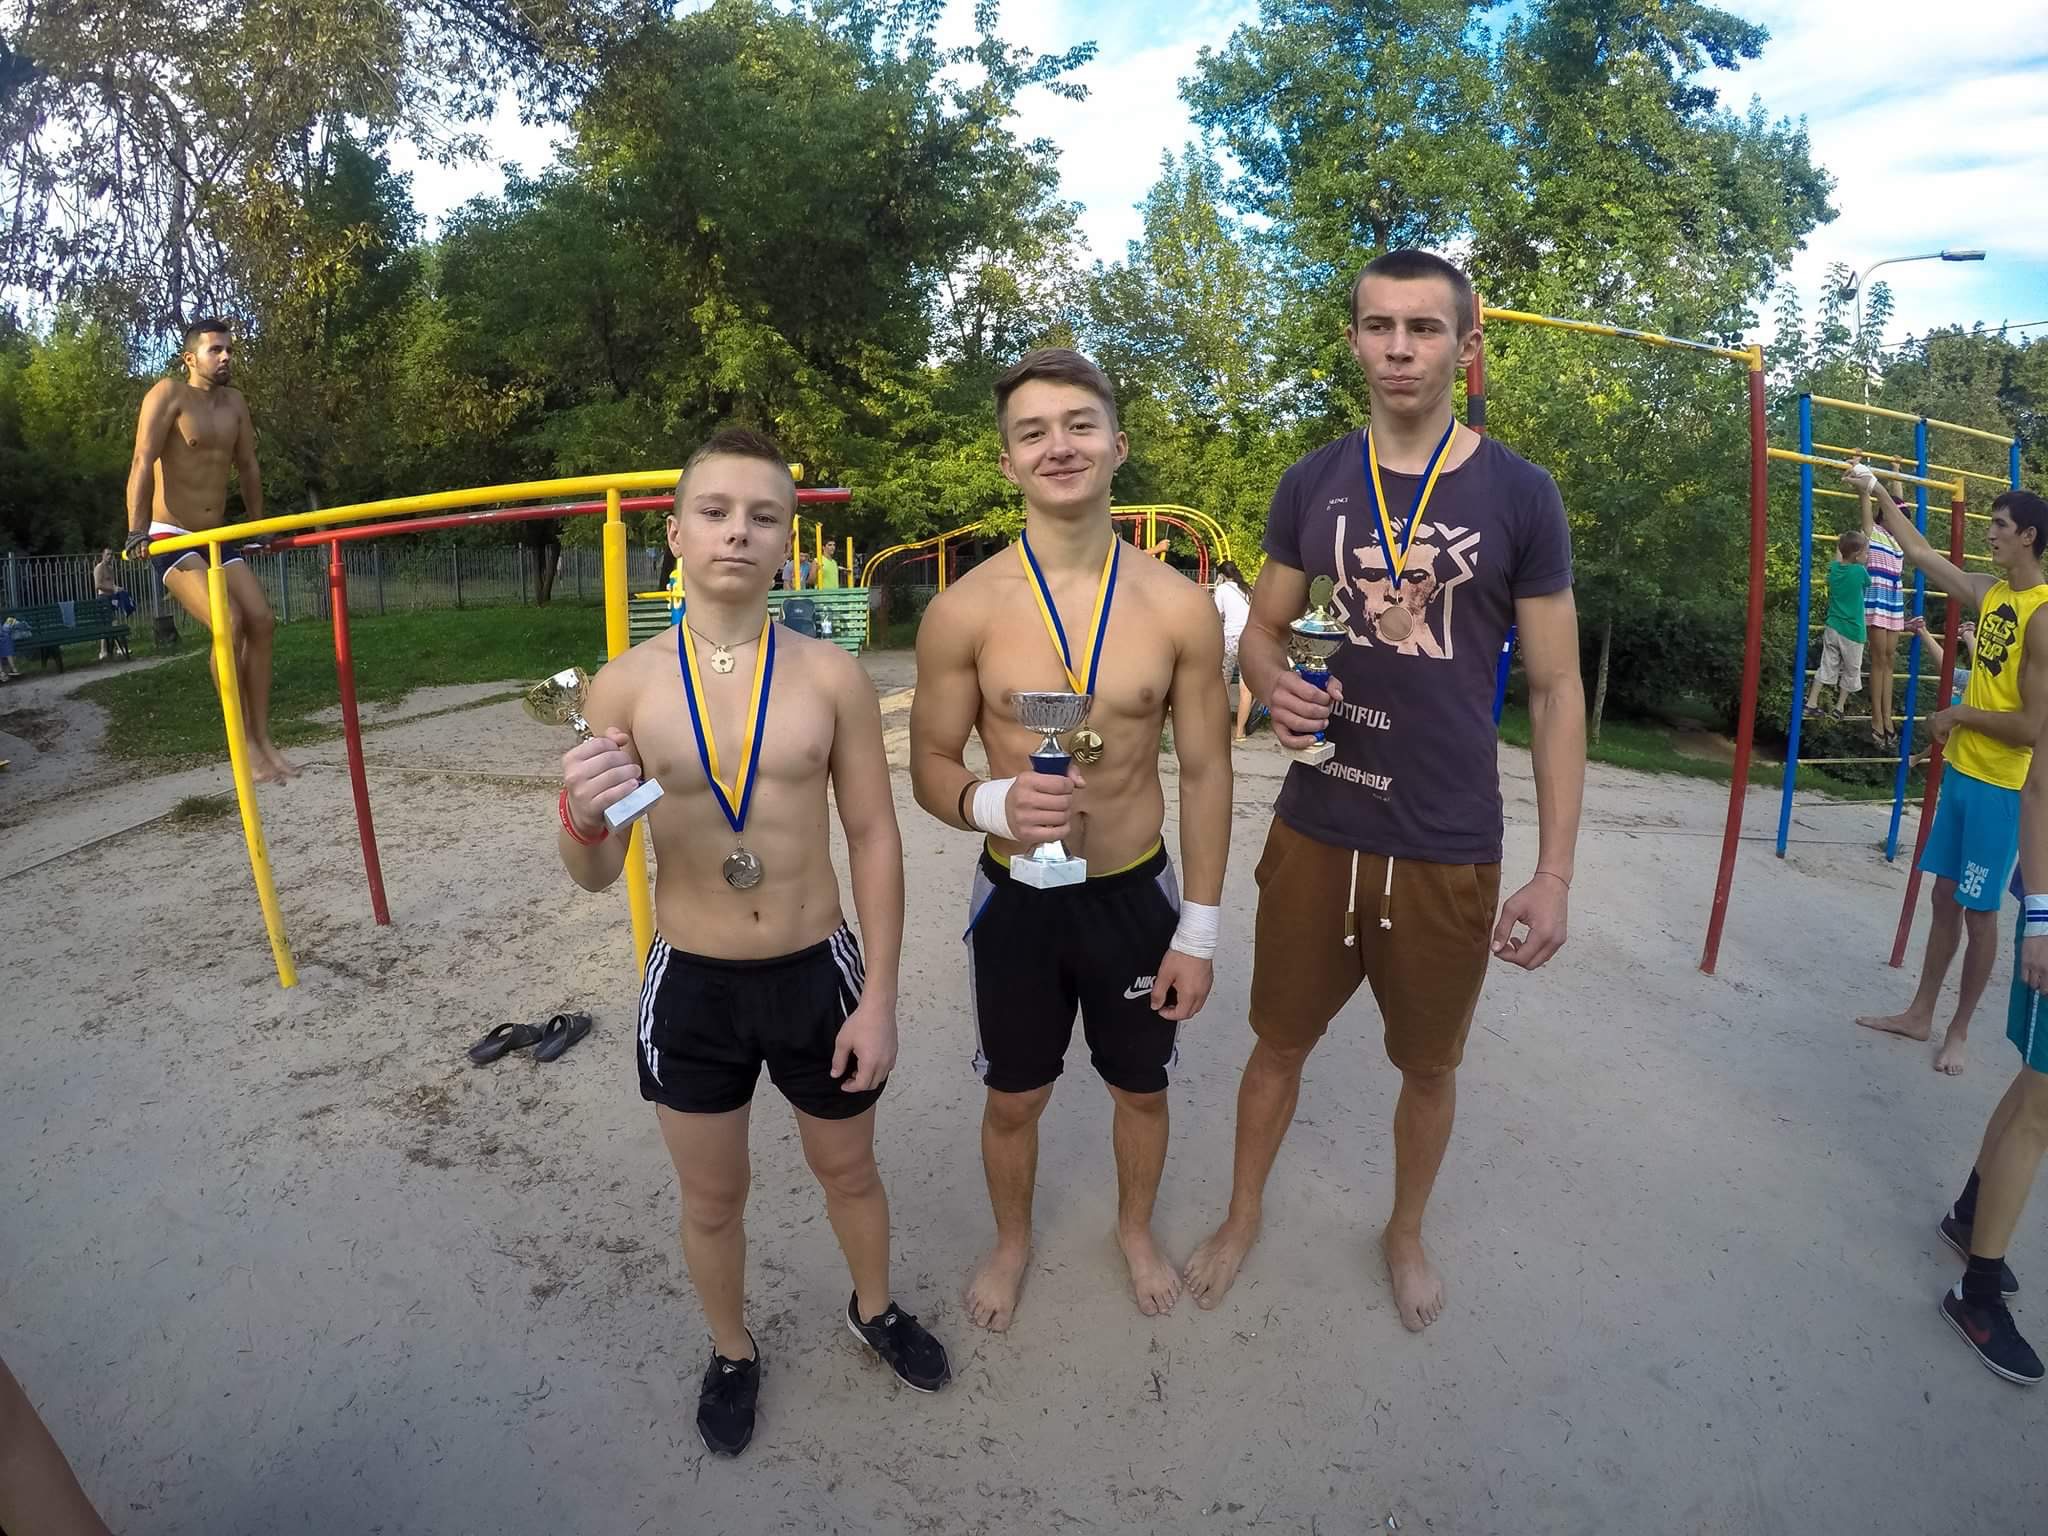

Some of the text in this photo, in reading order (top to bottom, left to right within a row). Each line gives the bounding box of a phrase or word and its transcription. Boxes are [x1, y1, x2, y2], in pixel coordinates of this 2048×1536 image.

[1328, 699, 1391, 730] UTIFUL
[1317, 761, 1392, 791] LANCHOLY
[1959, 870, 1986, 898] 36
[1134, 975, 1157, 989] NIK
